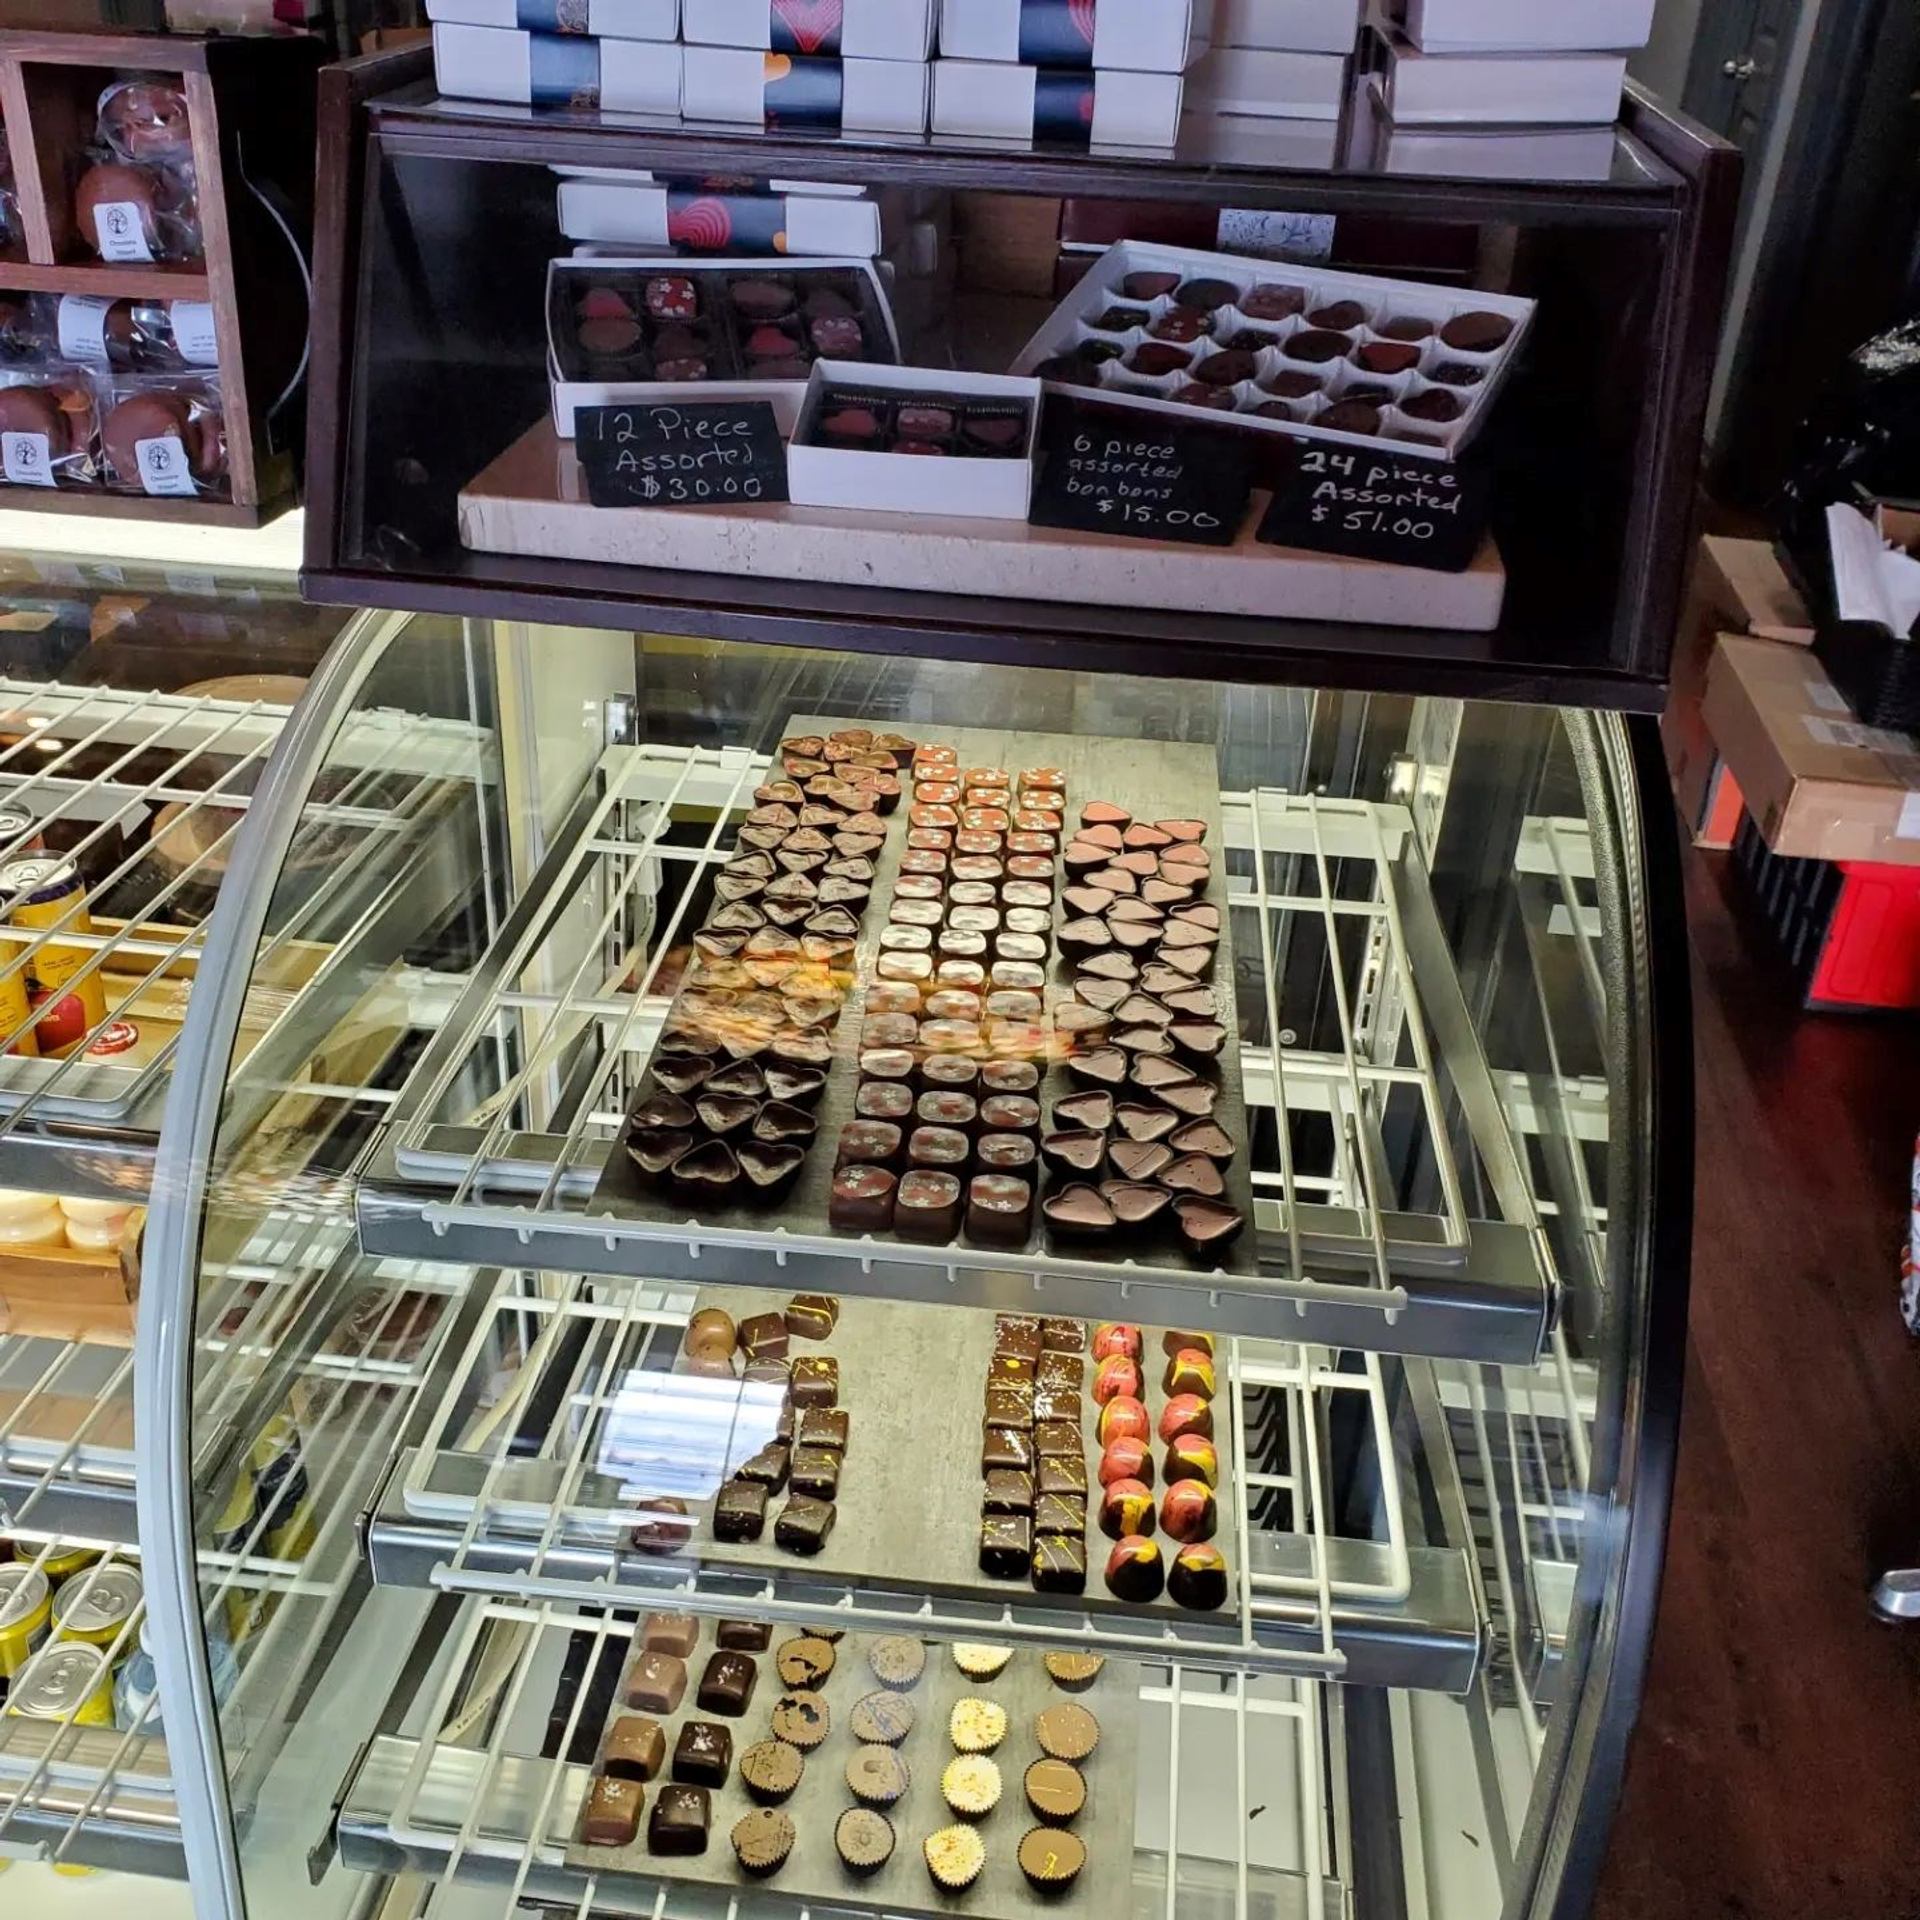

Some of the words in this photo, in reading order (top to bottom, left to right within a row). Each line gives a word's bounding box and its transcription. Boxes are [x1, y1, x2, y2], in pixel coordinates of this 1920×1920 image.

[598, 412, 639, 443] 12
[650, 407, 753, 440] Piece
[615, 443, 753, 472] Assorted
[1074, 434, 1092, 452] 6
[1104, 440, 1175, 459] piece
[1069, 458, 1183, 480] assorted
[1300, 451, 1356, 476] 24
[1365, 464, 1458, 488] piece
[1311, 481, 1462, 515] Assorted
